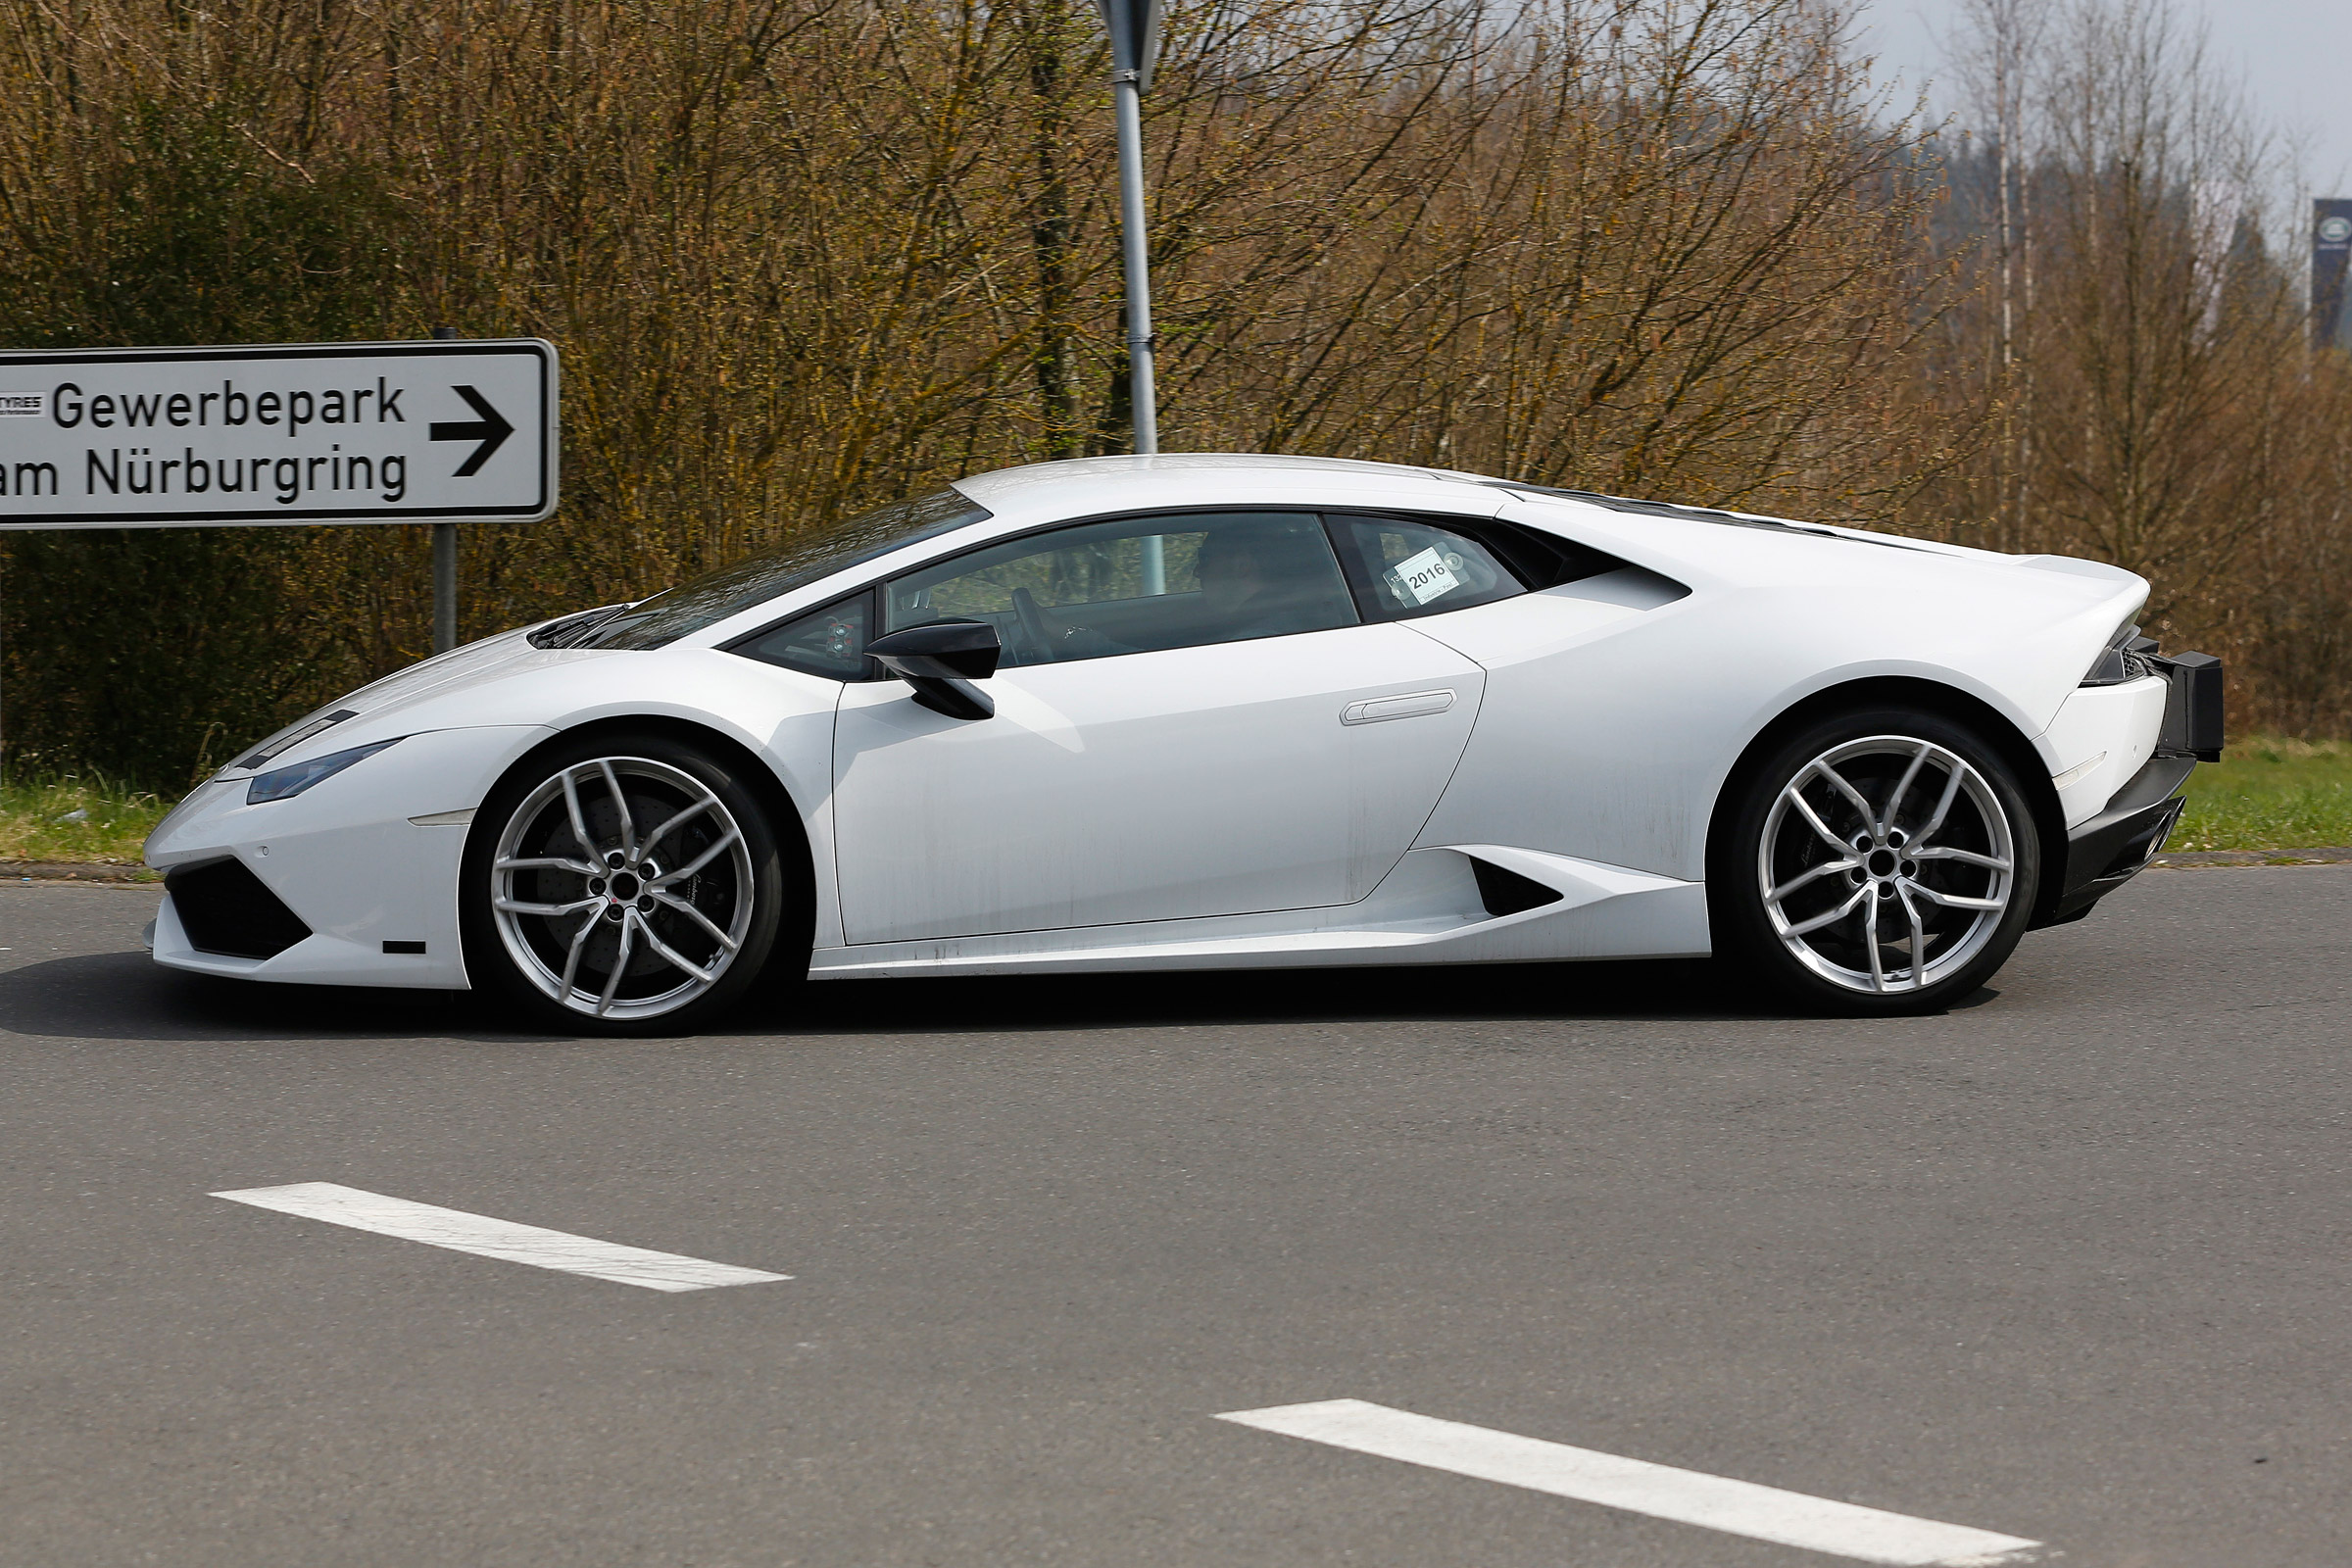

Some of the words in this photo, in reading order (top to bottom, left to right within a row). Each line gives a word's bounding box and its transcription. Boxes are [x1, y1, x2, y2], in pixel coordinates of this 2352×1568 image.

[53, 376, 407, 438] Gewerbepark
[85, 443, 407, 503] Nürburgring
[1409, 563, 1446, 590] 2016
